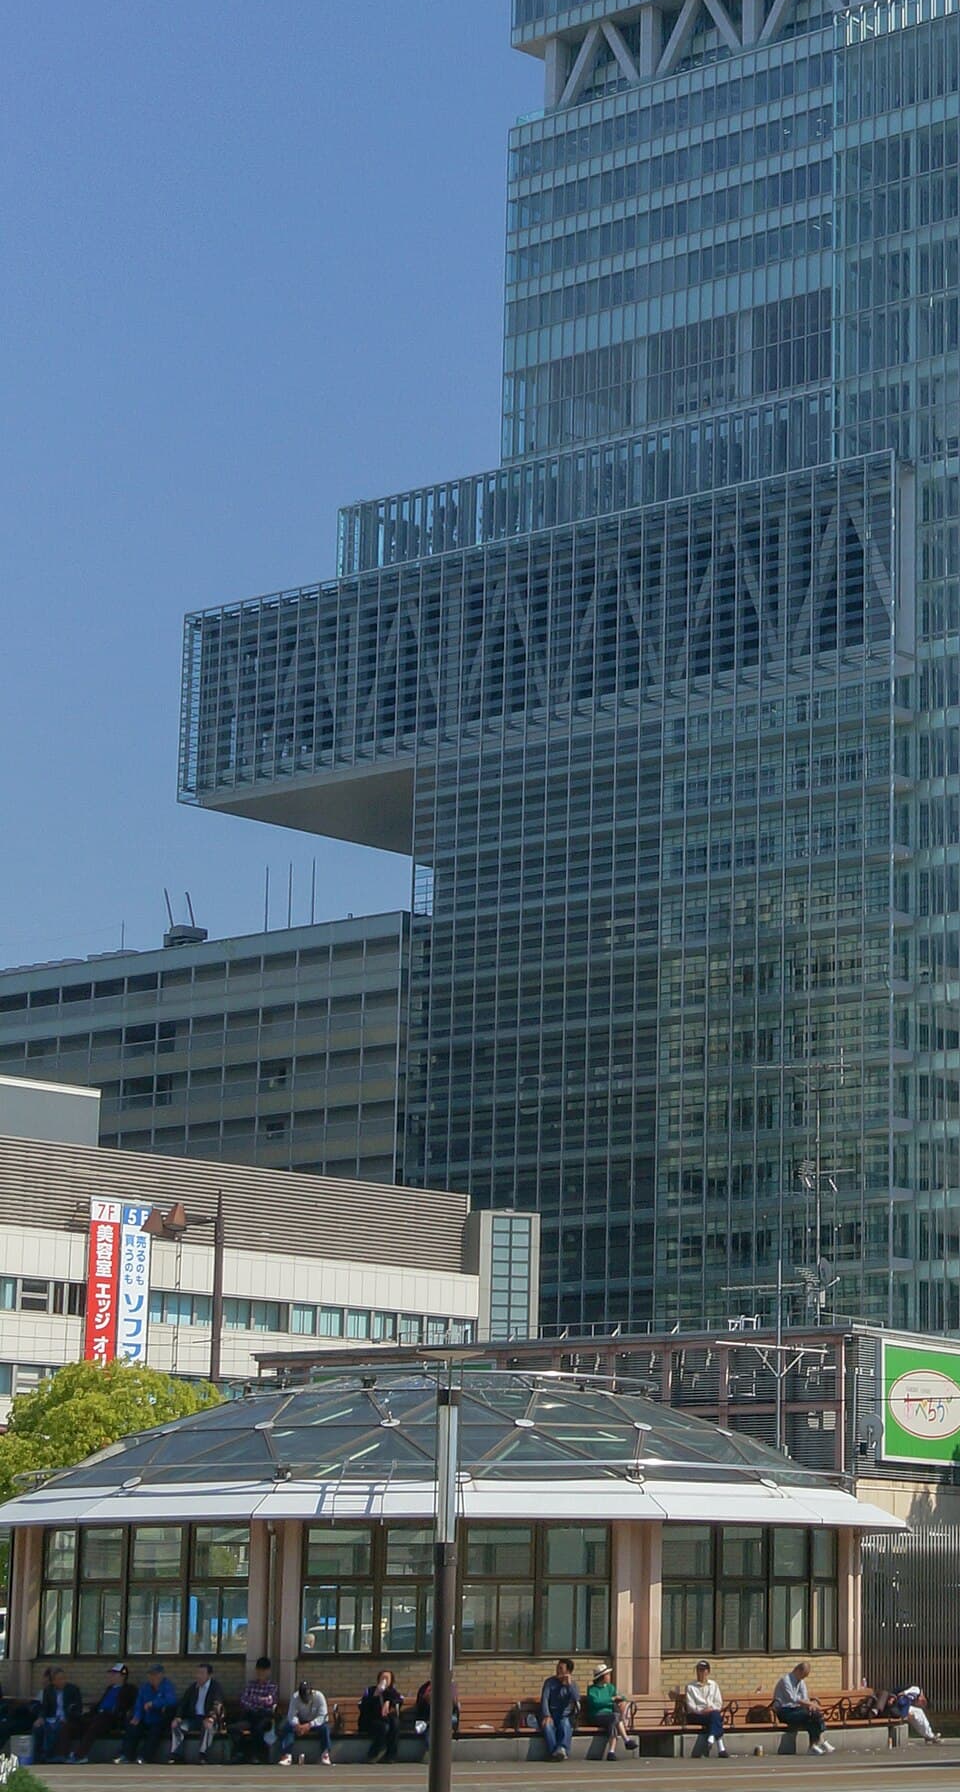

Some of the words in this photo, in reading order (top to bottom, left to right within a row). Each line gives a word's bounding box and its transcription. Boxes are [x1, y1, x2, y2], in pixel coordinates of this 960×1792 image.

[97, 1204, 116, 1220] 7F
[127, 1208, 149, 1226] 5F
[95, 1225, 114, 1278] 美容室
[124, 1234, 135, 1285] 買うのも
[94, 1283, 113, 1330] エッジ
